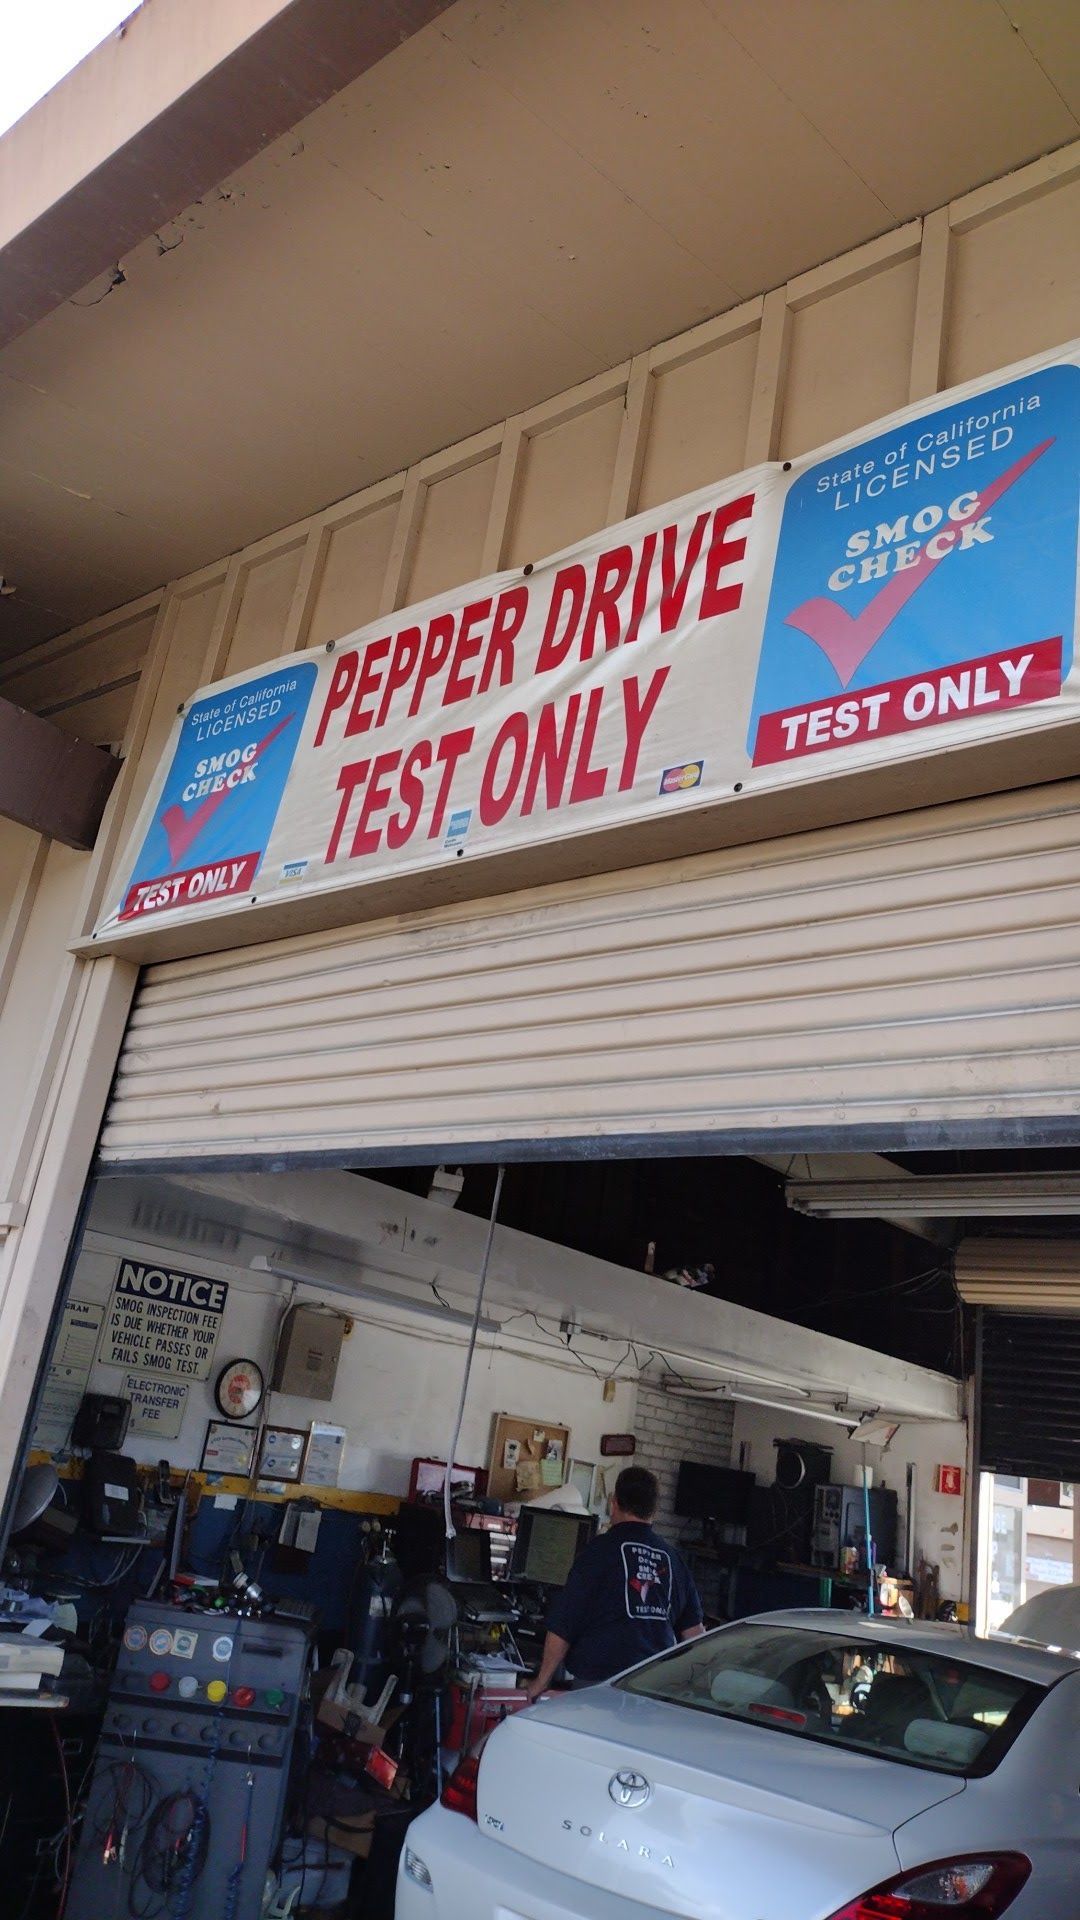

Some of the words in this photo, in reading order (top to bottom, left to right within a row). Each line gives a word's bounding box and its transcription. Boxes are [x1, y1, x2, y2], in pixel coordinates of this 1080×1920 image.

[816, 460, 874, 493] State
[883, 443, 909, 470] of
[916, 394, 1041, 452] California
[834, 425, 1016, 511] LICENSED
[846, 490, 981, 559] SMOG
[827, 516, 995, 592] CHECK
[314, 586, 529, 747] PEPPER
[535, 493, 756, 674] DRIVE
[191, 708, 221, 727] State
[224, 699, 238, 714] of
[239, 679, 298, 708] California
[196, 700, 282, 742] LICENSED
[780, 692, 890, 751] TEST
[902, 654, 1035, 722] ONLY
[194, 743, 258, 778] SMOG
[324, 727, 475, 864] TEST
[479, 665, 671, 826] ONLY
[182, 763, 257, 801] CHECK
[133, 877, 185, 912] TEST
[187, 861, 247, 898] ONLY
[120, 1264, 224, 1309] NOTICE
[111, 1313, 121, 1326] IS
[124, 1316, 143, 1330] DUE
[147, 1320, 188, 1339] WHETHER
[193, 1330, 215, 1344] YOUR
[115, 1297, 143, 1313] SMOG
[147, 1303, 199, 1325] INSPECTION
[202, 1314, 218, 1329] FEE
[111, 1347, 138, 1364] FAILS
[143, 1353, 172, 1370] SMOG
[176, 1359, 199, 1374] TEST.
[112, 1330, 151, 1349] VEHICLE
[155, 1338, 191, 1357] PASSES
[195, 1346, 208, 1360] OR
[127, 1378, 186, 1397] ELECTRONIC
[129, 1392, 180, 1409] TRANSFER
[142, 1408, 160, 1419] FEE
[636, 1572, 661, 1584] CHEK
[651, 1607, 667, 1615] ONL
[561, 1819, 676, 1868] SOLARA
